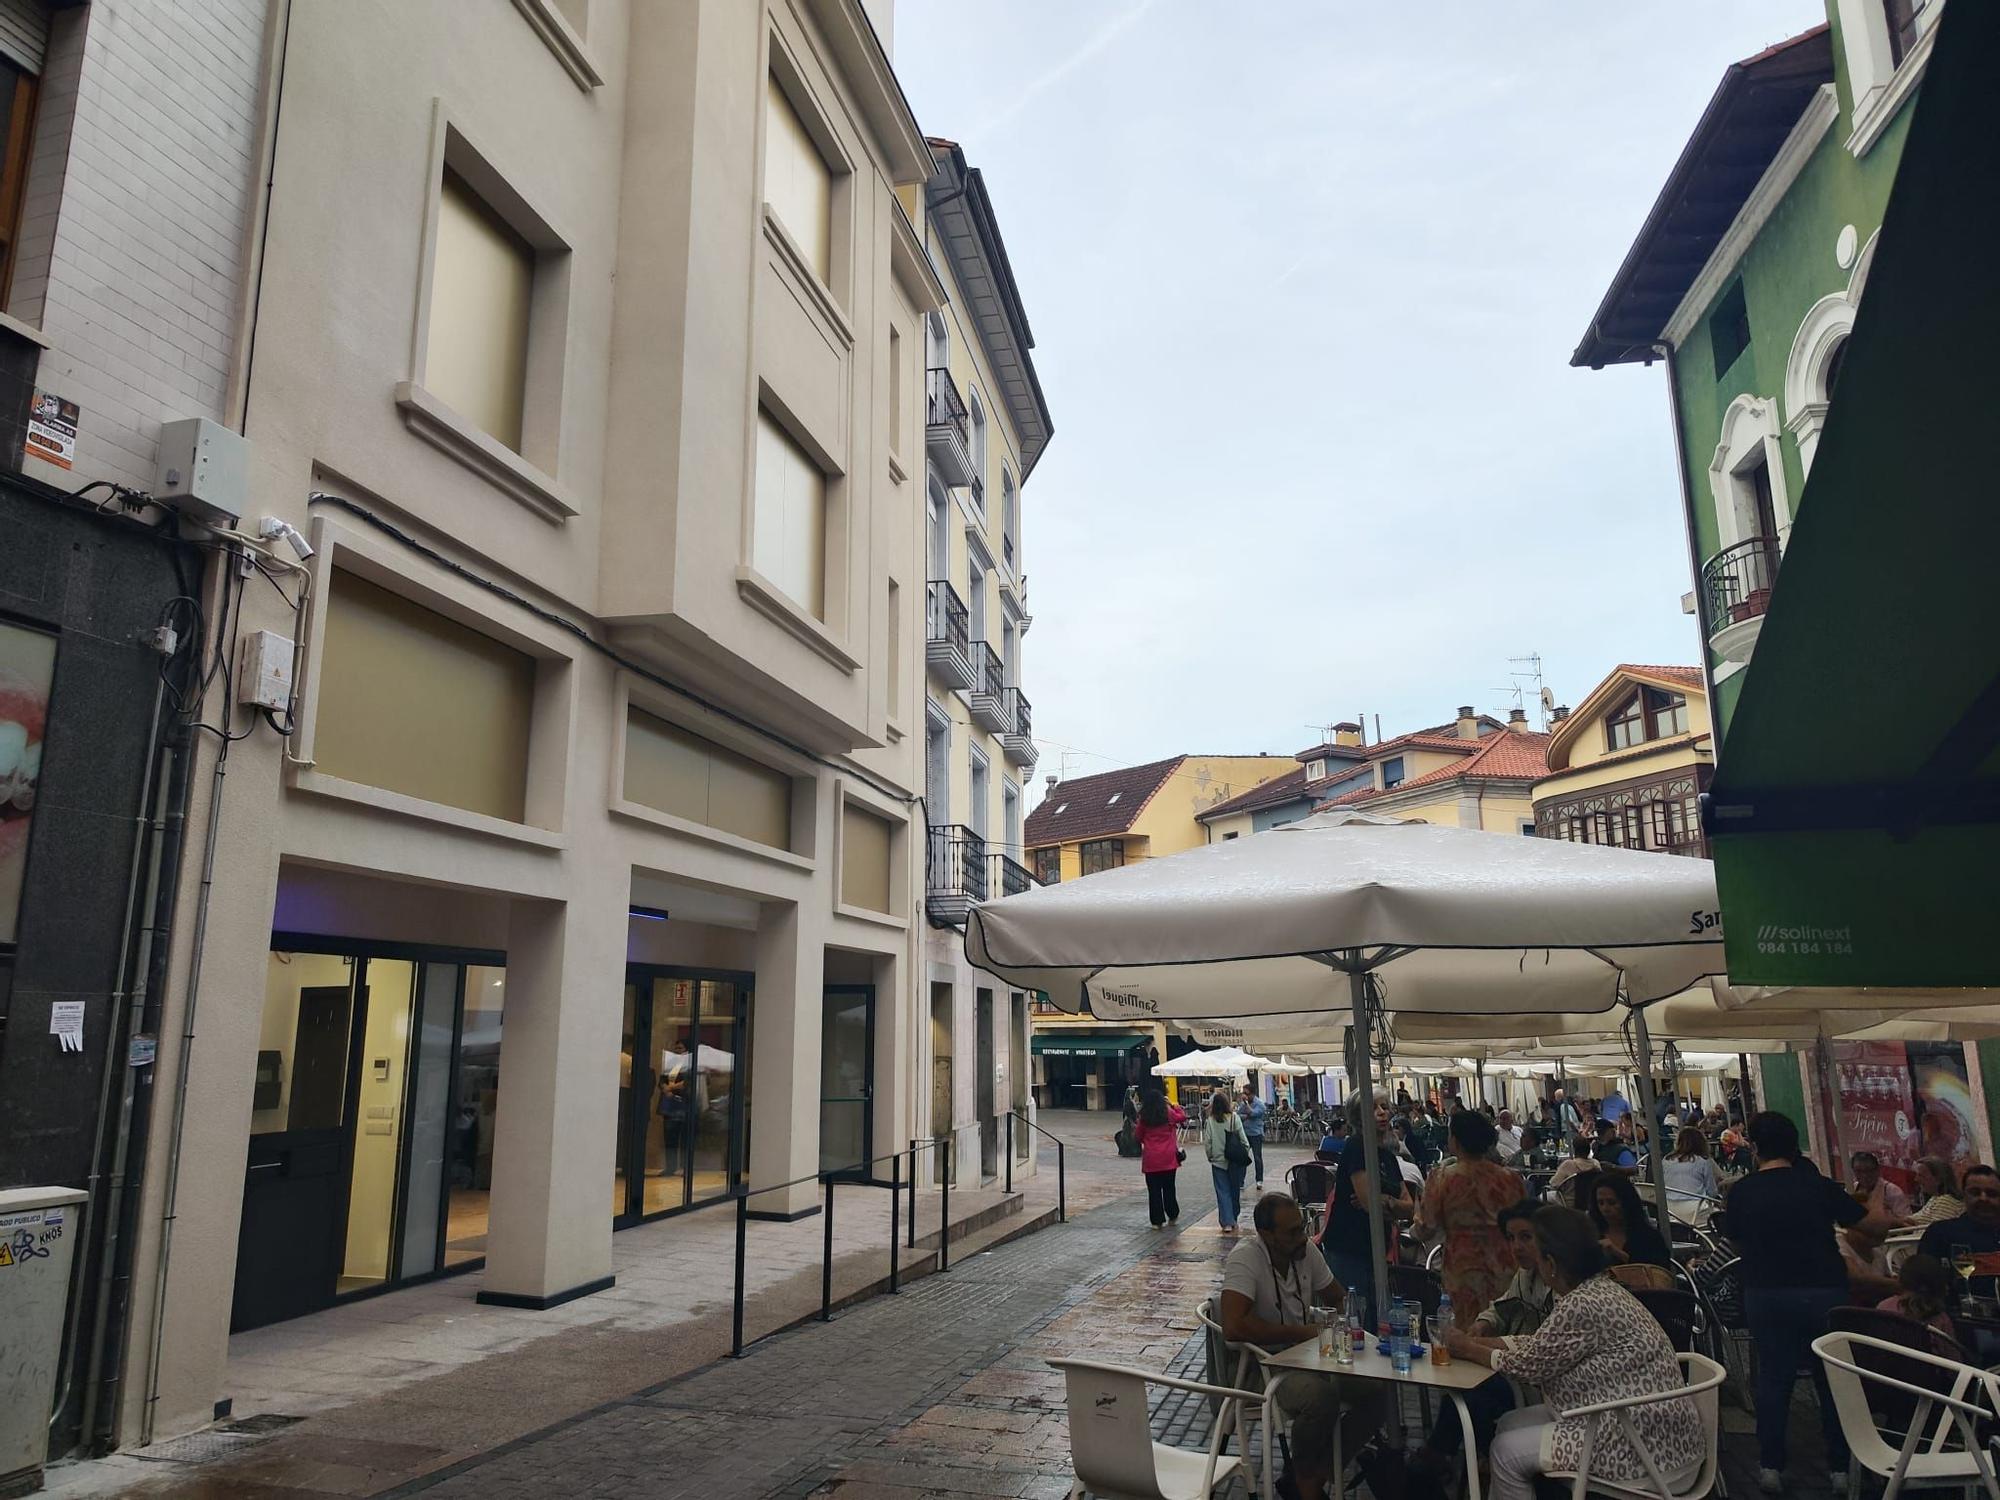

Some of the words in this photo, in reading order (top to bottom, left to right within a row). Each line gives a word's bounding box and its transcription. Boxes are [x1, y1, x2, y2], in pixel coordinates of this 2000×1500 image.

[1758, 942, 1786, 955] 984
[1792, 942, 1821, 955] 184
[1826, 942, 1853, 955] 184
